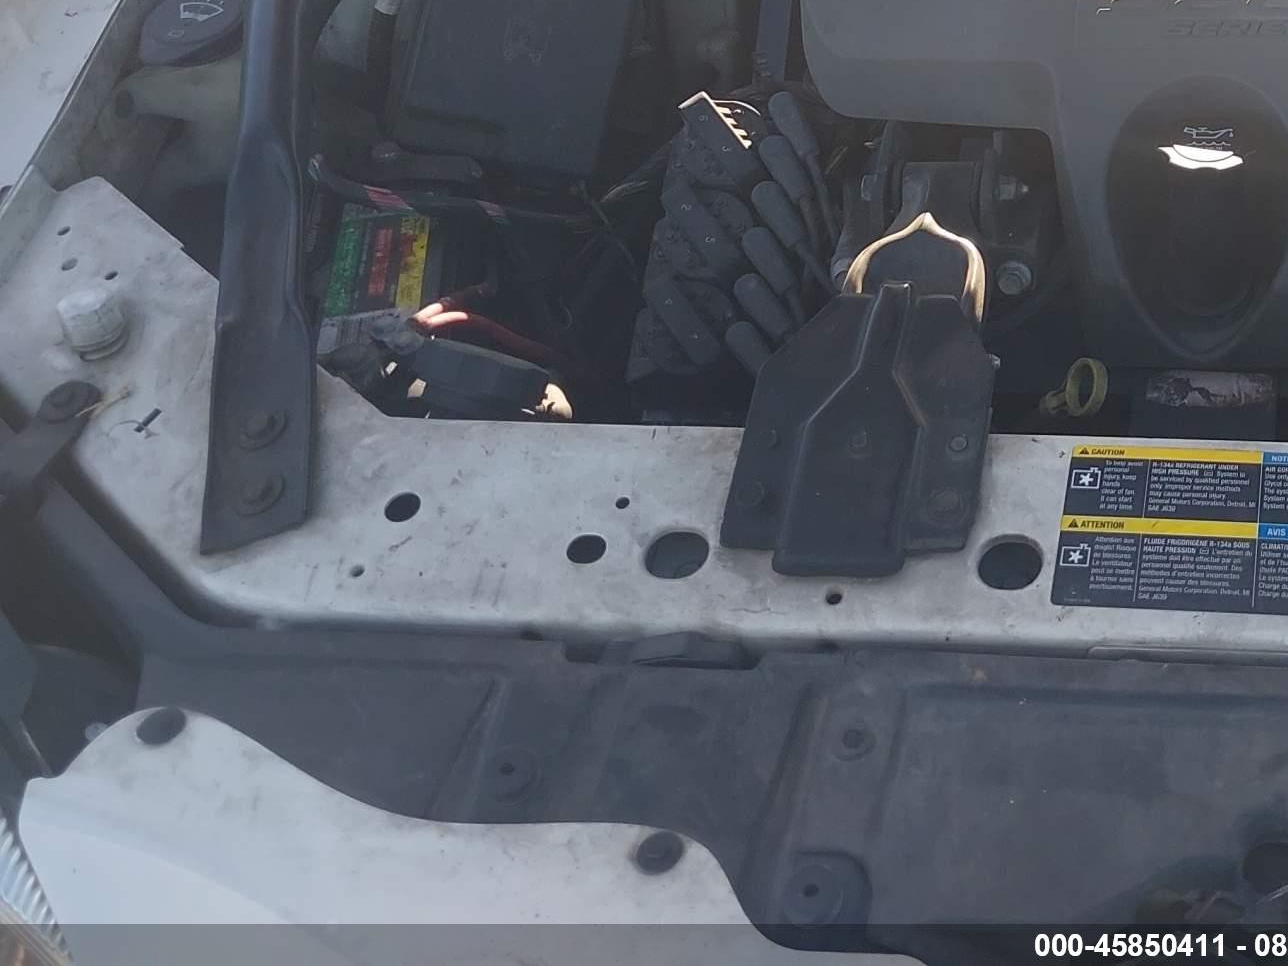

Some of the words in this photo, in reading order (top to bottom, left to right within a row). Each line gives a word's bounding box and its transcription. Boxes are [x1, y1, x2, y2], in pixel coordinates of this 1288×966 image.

[1080, 520, 1125, 528] ATTENTION
[1266, 527, 1286, 536] AVIS
[1164, 546, 1196, 554] PRESSION
